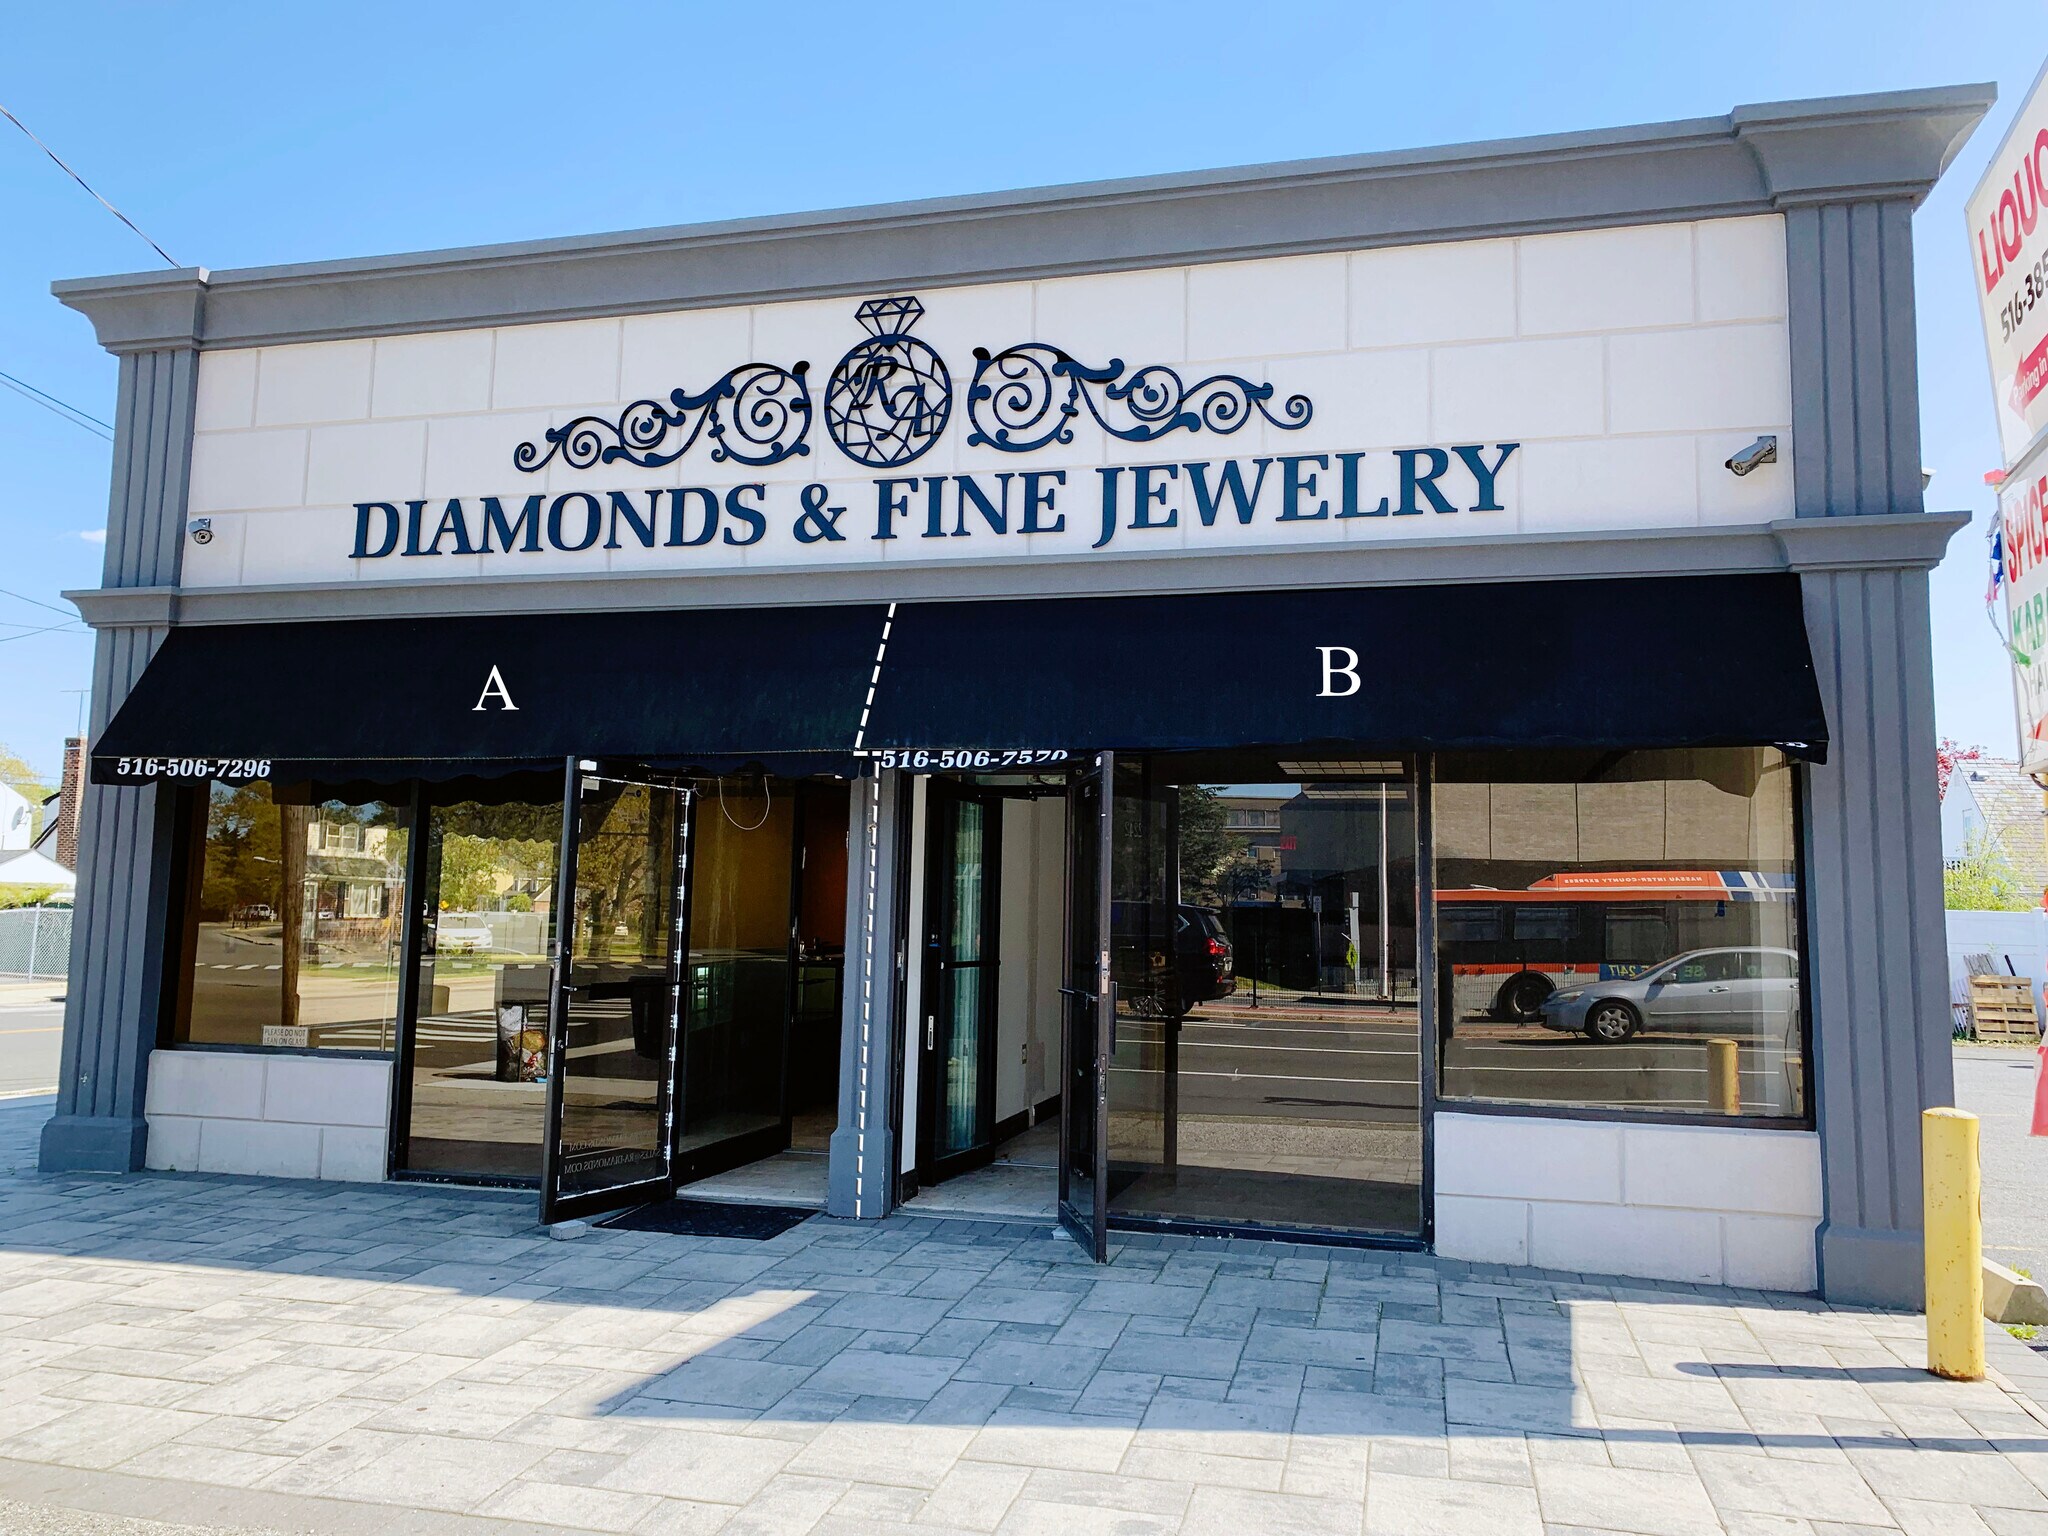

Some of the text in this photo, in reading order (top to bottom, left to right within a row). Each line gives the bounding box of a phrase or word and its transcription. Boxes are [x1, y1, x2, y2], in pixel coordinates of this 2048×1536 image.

[348, 442, 1521, 559] DIAMONDS & FINE JEWELRY
[2012, 586, 2048, 651] KAB
[117, 757, 271, 778] 516-506-7296
[263, 1037, 278, 1045] LEAN
[288, 1038, 306, 1046] GLASS
[264, 1028, 306, 1038] PLEASE DO NOT
